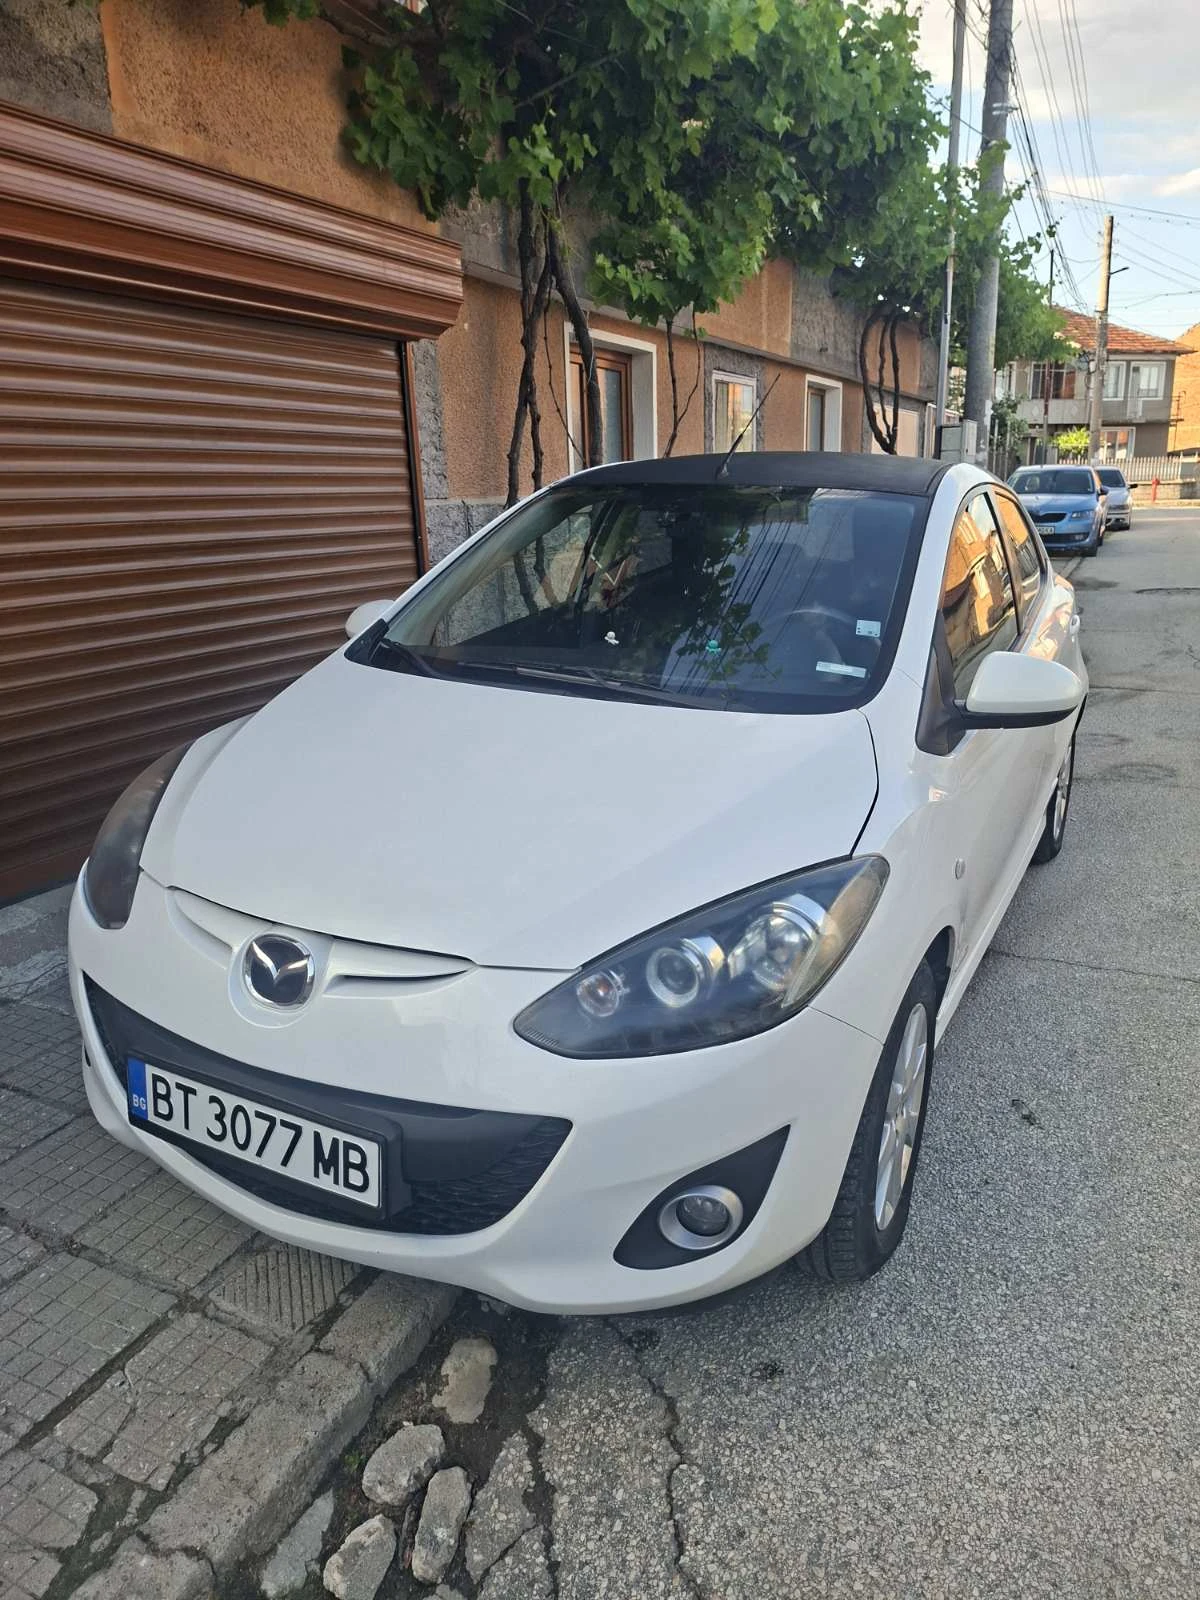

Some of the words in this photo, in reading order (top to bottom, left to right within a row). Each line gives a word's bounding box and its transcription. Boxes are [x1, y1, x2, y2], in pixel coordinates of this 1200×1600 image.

[132, 1094, 147, 1111] BG
[151, 1072, 198, 1131] BT
[206, 1094, 303, 1168] 3077
[312, 1130, 370, 1193] MB
